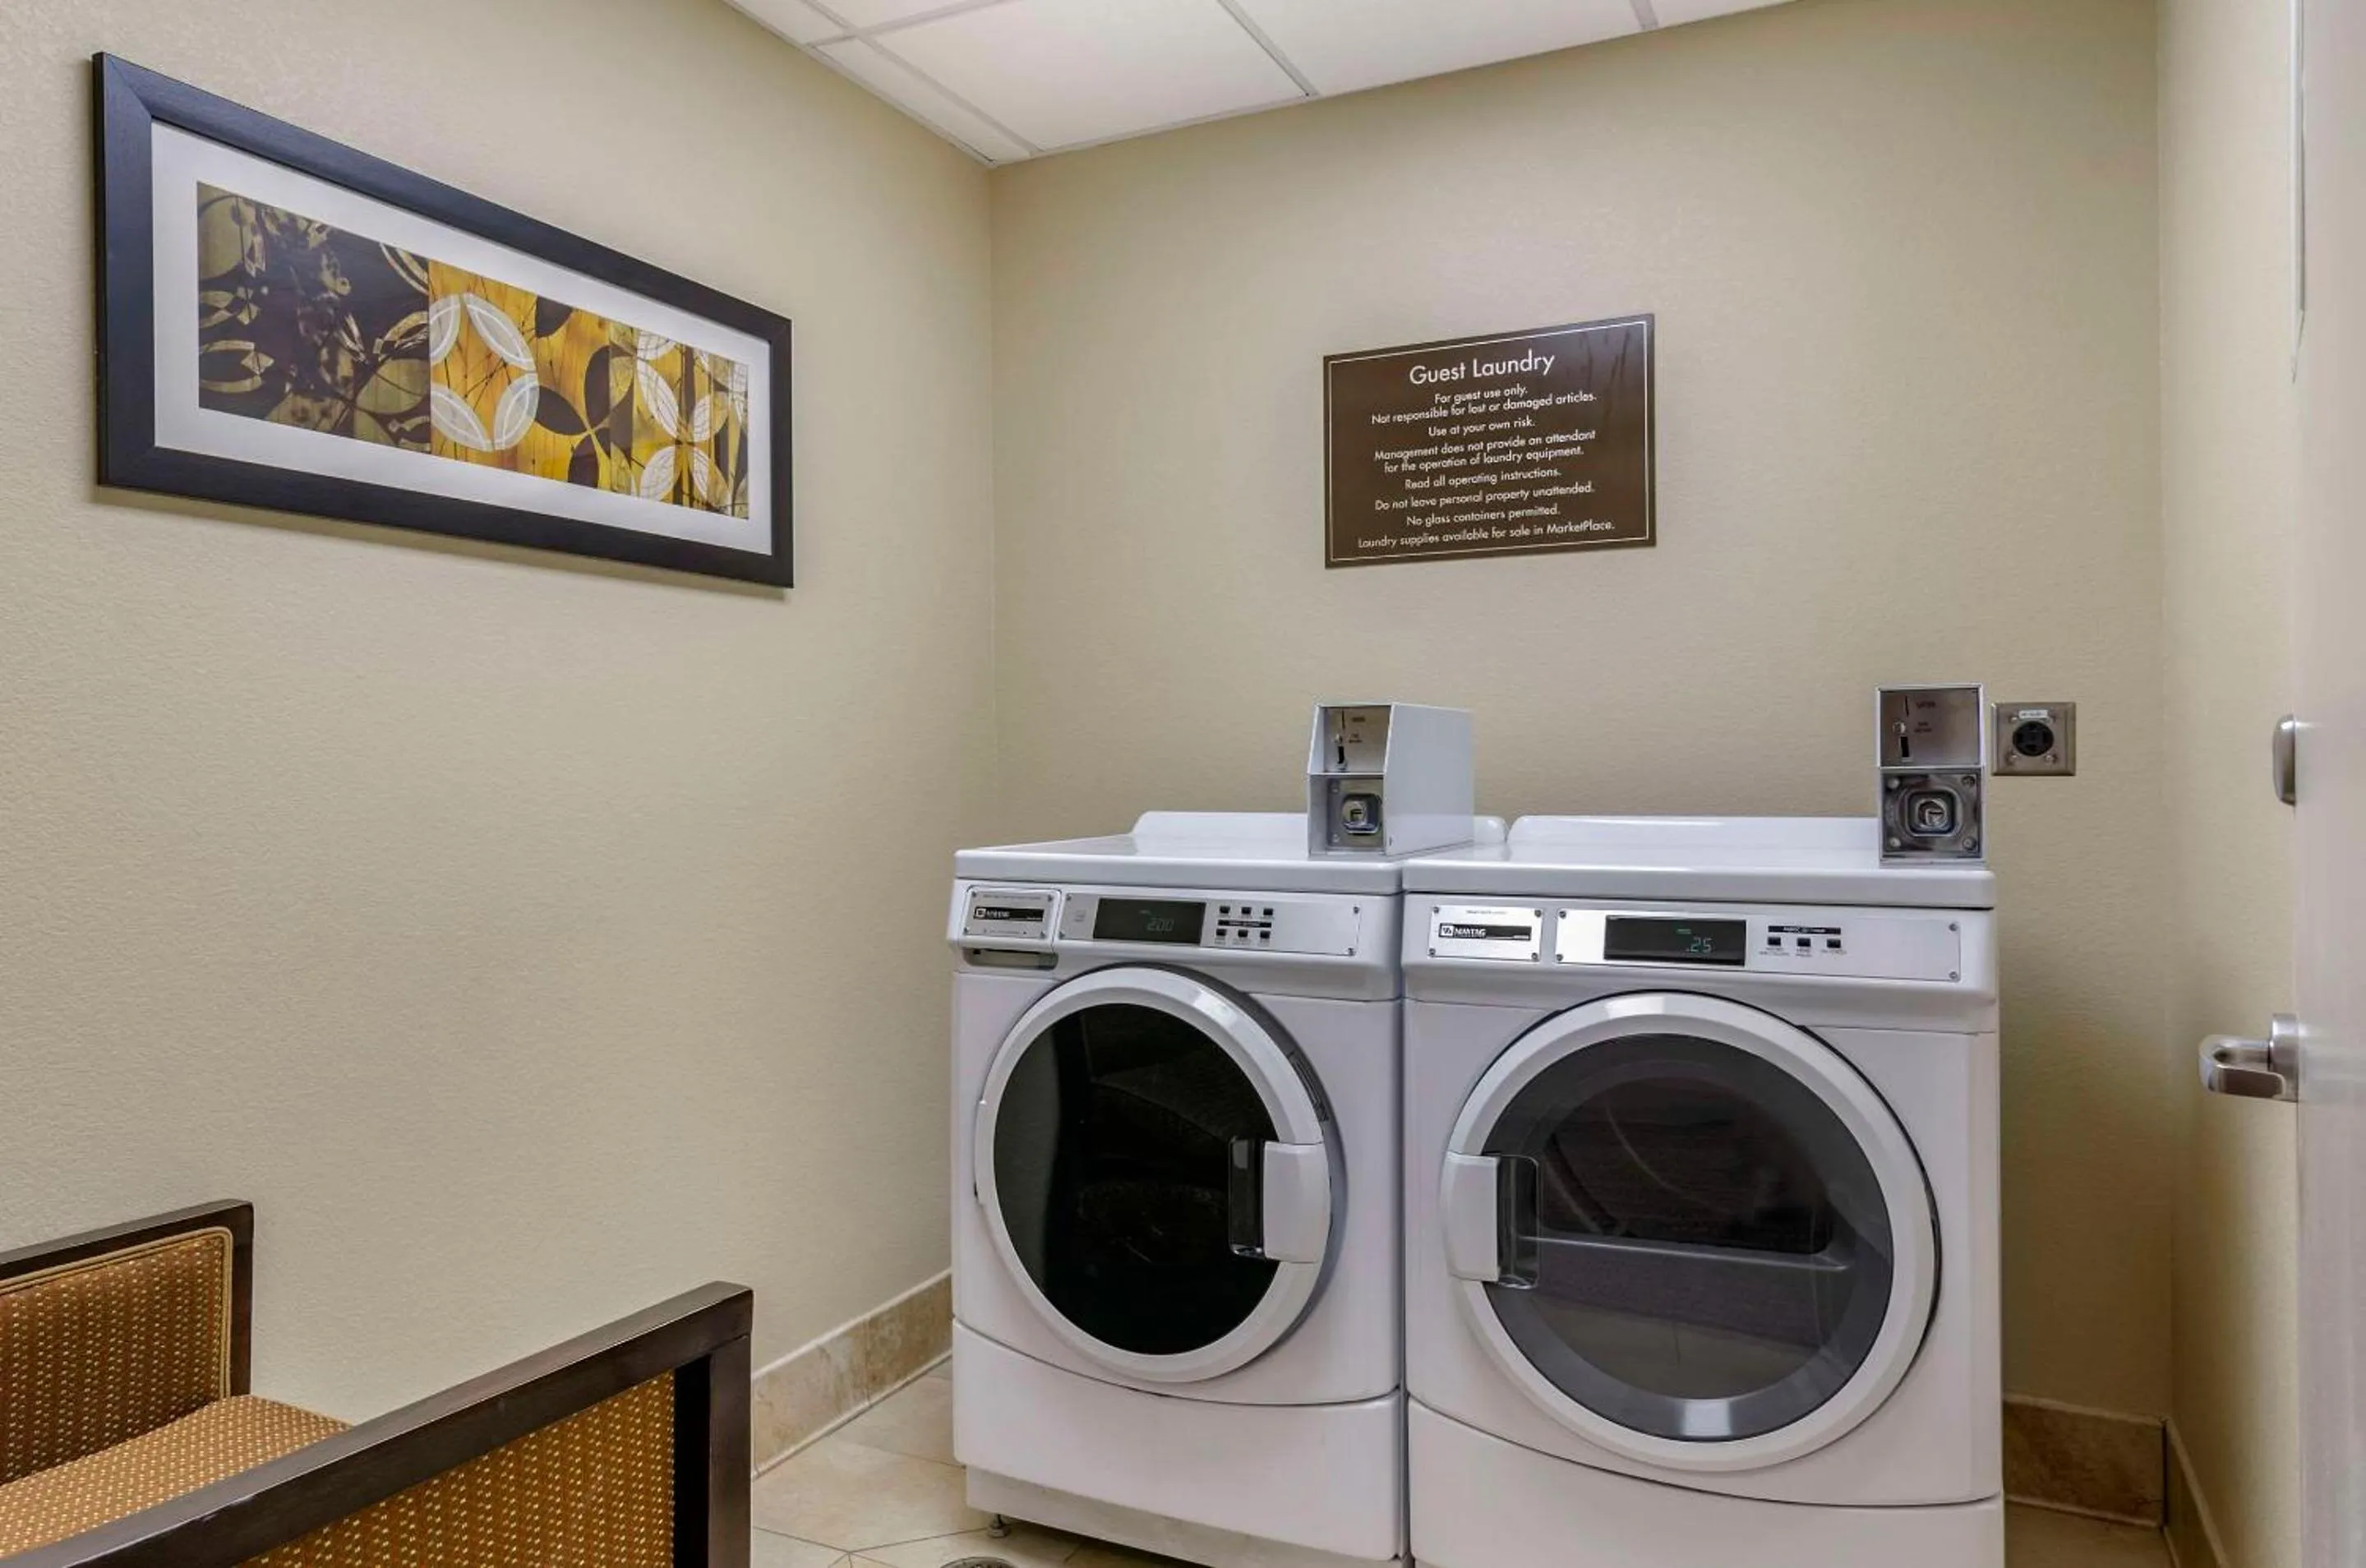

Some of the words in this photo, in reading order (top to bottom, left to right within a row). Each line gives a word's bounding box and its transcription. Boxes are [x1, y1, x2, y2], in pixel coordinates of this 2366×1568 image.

[1409, 362, 1465, 385] Guest
[1473, 348, 1555, 378] Laundry
[1435, 393, 1451, 404] For
[1454, 391, 1480, 404] guest
[1483, 389, 1501, 399] use
[1504, 383, 1528, 398] only.
[1372, 413, 1391, 424] Not
[1392, 407, 1448, 423] responsible
[1451, 404, 1465, 415] for
[1468, 402, 1486, 413] lost
[1488, 403, 1500, 412] or
[1502, 393, 1552, 409] damaged
[1555, 390, 1598, 404] articles.
[1428, 427, 1447, 436] Use
[1449, 425, 1460, 435] at
[1463, 422, 1487, 436] your
[1488, 421, 1510, 431] own
[1513, 414, 1535, 427] risk.
[1374, 445, 1438, 461] Management
[1441, 443, 1464, 454] does
[1468, 441, 1483, 451] not
[1487, 435, 1525, 452] provide
[1528, 436, 1542, 446] an
[1545, 428, 1596, 444] attendant
[1384, 462, 1399, 473] for
[1401, 459, 1416, 471] the
[1418, 456, 1467, 472] operation
[1469, 453, 1480, 465] of
[1483, 450, 1522, 463] laundry
[1526, 445, 1584, 462] equipment.
[1404, 476, 1430, 489] Read
[1433, 474, 1446, 487] all
[1448, 473, 1497, 488] operating
[1375, 500, 1390, 510] Do
[1392, 500, 1408, 509] not
[1411, 496, 1437, 507] leave
[1439, 490, 1483, 508] personal
[1485, 489, 1529, 504] property
[1406, 515, 1423, 526] No
[1425, 513, 1451, 528] glass
[1453, 510, 1505, 523] containers
[1358, 534, 1397, 549] Laundry
[1400, 533, 1439, 546] supplies
[1442, 528, 1488, 542] available
[1492, 526, 1506, 538] for
[1510, 524, 1530, 537] sale
[1534, 524, 1543, 534] in
